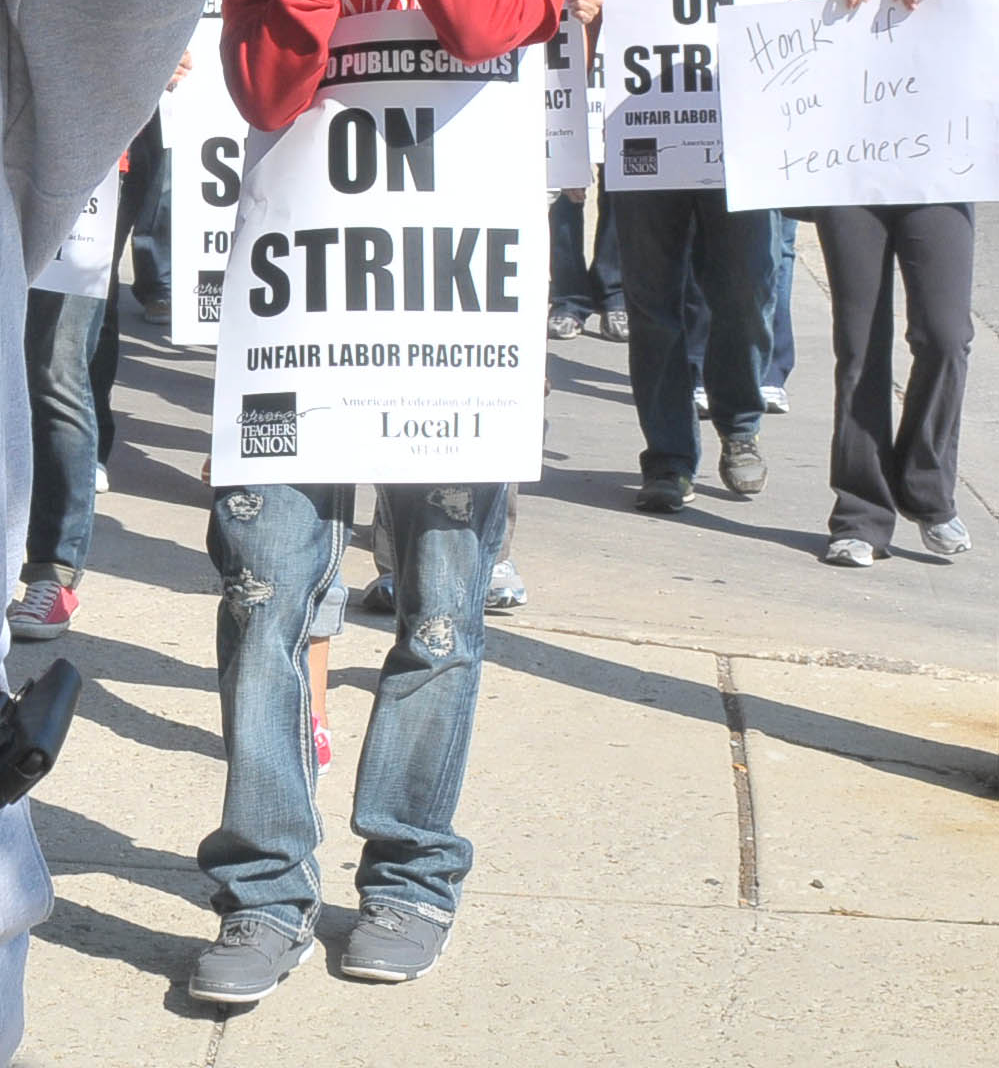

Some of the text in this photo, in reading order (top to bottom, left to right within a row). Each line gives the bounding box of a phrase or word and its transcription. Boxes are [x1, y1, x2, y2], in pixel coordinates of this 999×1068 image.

[745, 6, 899, 74] Honk if
[341, 49, 415, 77] PUBLIC
[623, 43, 719, 95] STR
[625, 109, 717, 126] UNFAIR LABOR
[779, 92, 823, 132] you
[328, 107, 435, 194] ON
[249, 226, 520, 318] STRIKE
[246, 343, 519, 371] UNFAIR LABOR PRACTICES
[340, 397, 397, 407] American
[401, 396, 459, 407] Federation
[241, 422, 297, 438] TEACHERS
[380, 411, 481, 439] Local 1
[241, 436, 297, 455] UNION
